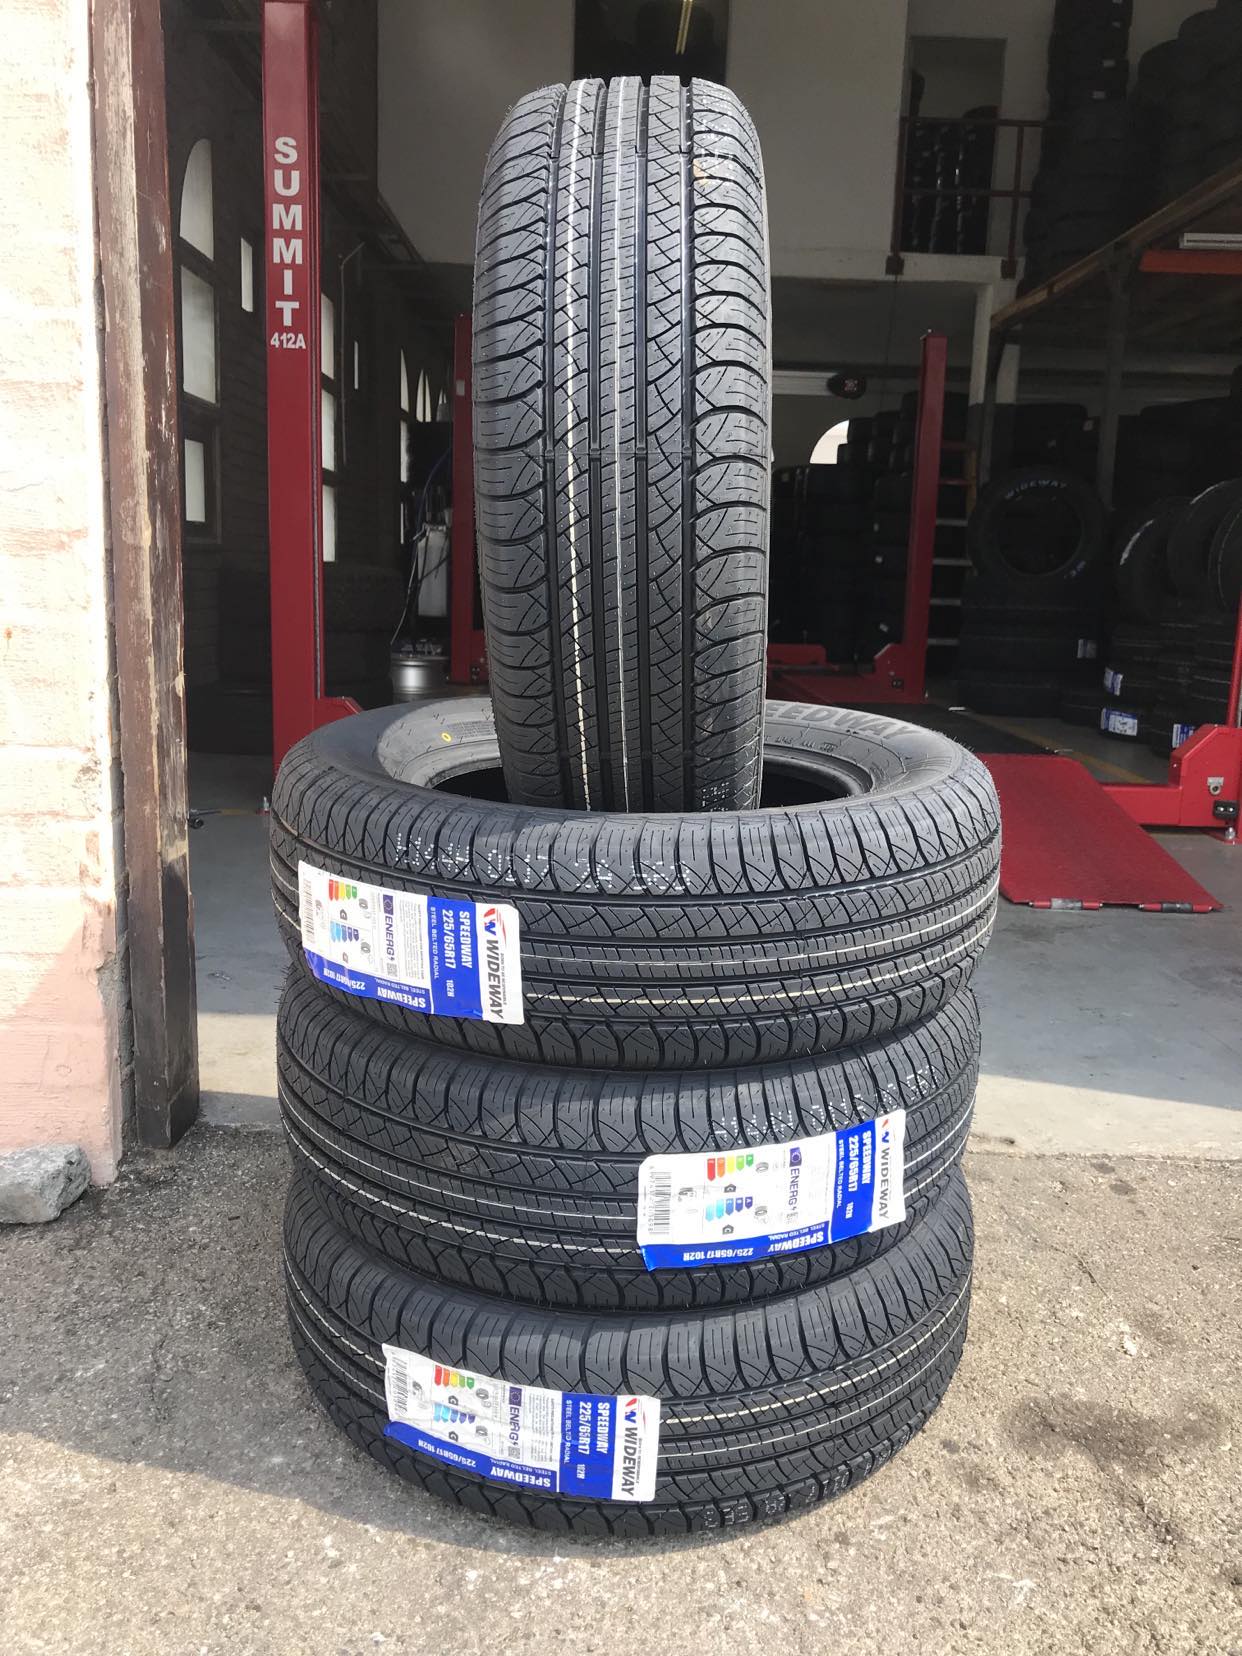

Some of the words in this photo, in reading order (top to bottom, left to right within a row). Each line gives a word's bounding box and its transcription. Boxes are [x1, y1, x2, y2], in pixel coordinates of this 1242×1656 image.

[272, 136, 303, 326] SUMMIT
[270, 332, 307, 349] 412A
[430, 907, 438, 927] STEEL
[442, 909, 456, 969] 225/65R17
[459, 911, 472, 968] SPEEDWAY
[377, 986, 426, 1008] SPEEDWAY
[485, 939, 504, 1019] WIDEWAY
[848, 1135, 859, 1192] 225/65R17
[861, 1130, 872, 1184] SPEEDWAY
[789, 1168, 800, 1206] ENERG
[879, 1148, 890, 1220] WIDEWAY
[683, 1250, 705, 1261] 102H
[706, 1247, 754, 1259] 225/65R17
[767, 1231, 824, 1252] SPEEDWAY
[563, 1442, 571, 1464] RADIAL
[577, 1401, 592, 1455] 225/65R17
[596, 1402, 610, 1454] SPEEDWAY
[490, 1466, 551, 1488] SPEEDWAY
[621, 1427, 638, 1496] WIDEWAY
